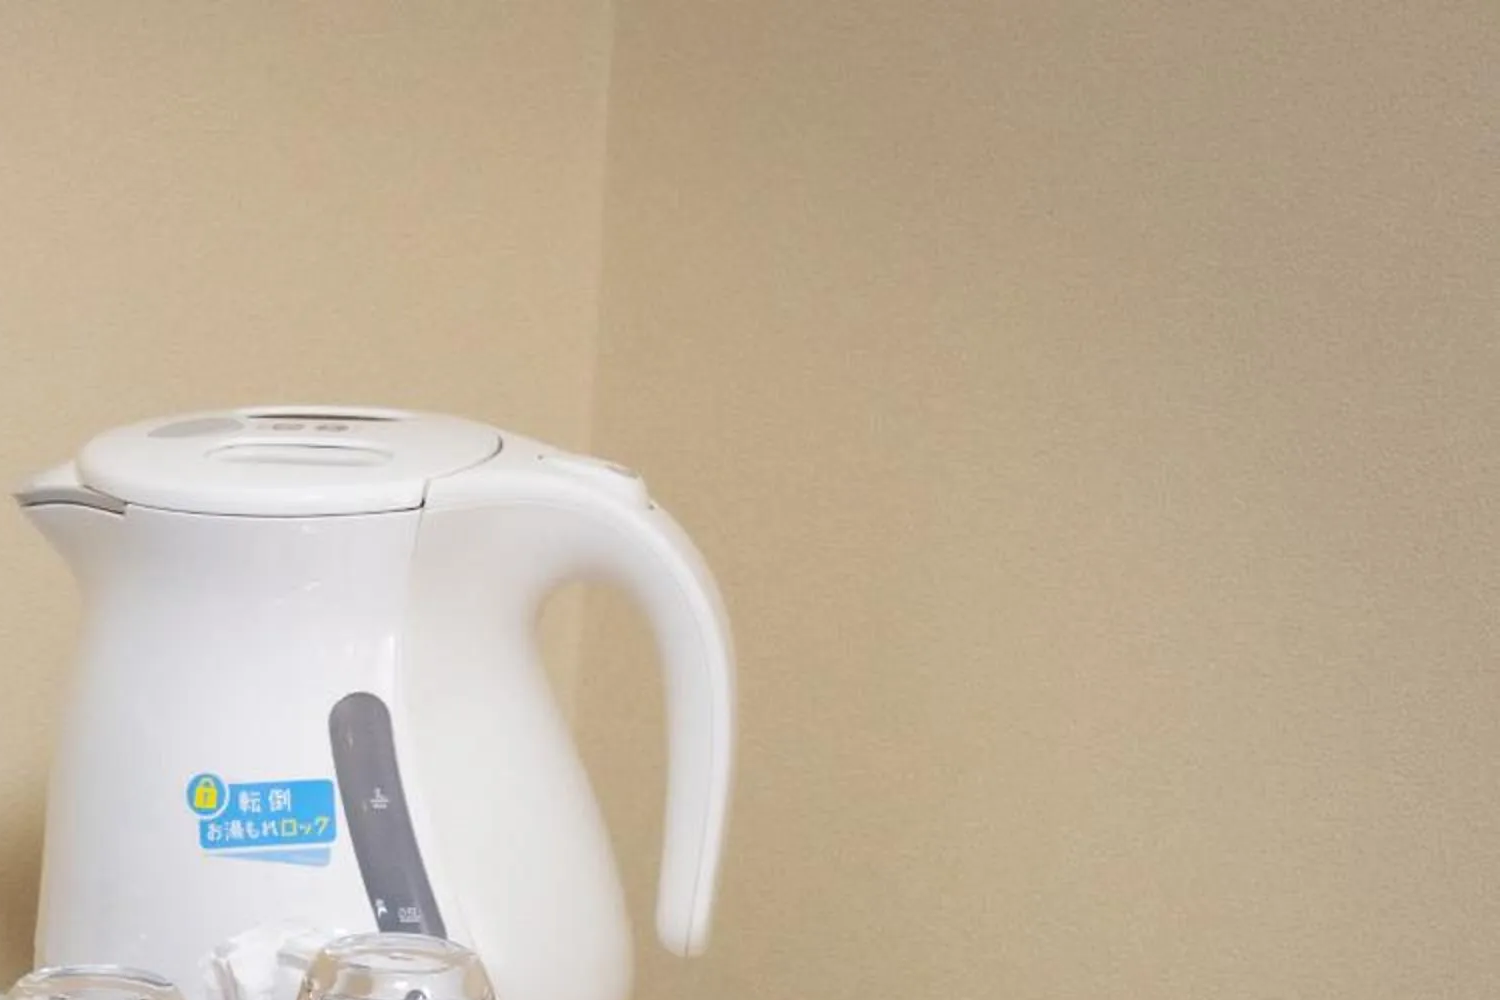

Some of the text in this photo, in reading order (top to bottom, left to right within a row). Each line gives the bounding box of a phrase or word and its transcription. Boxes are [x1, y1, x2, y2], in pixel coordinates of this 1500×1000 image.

[238, 789, 292, 813] 転倒
[206, 815, 331, 842] お湯もれロック
